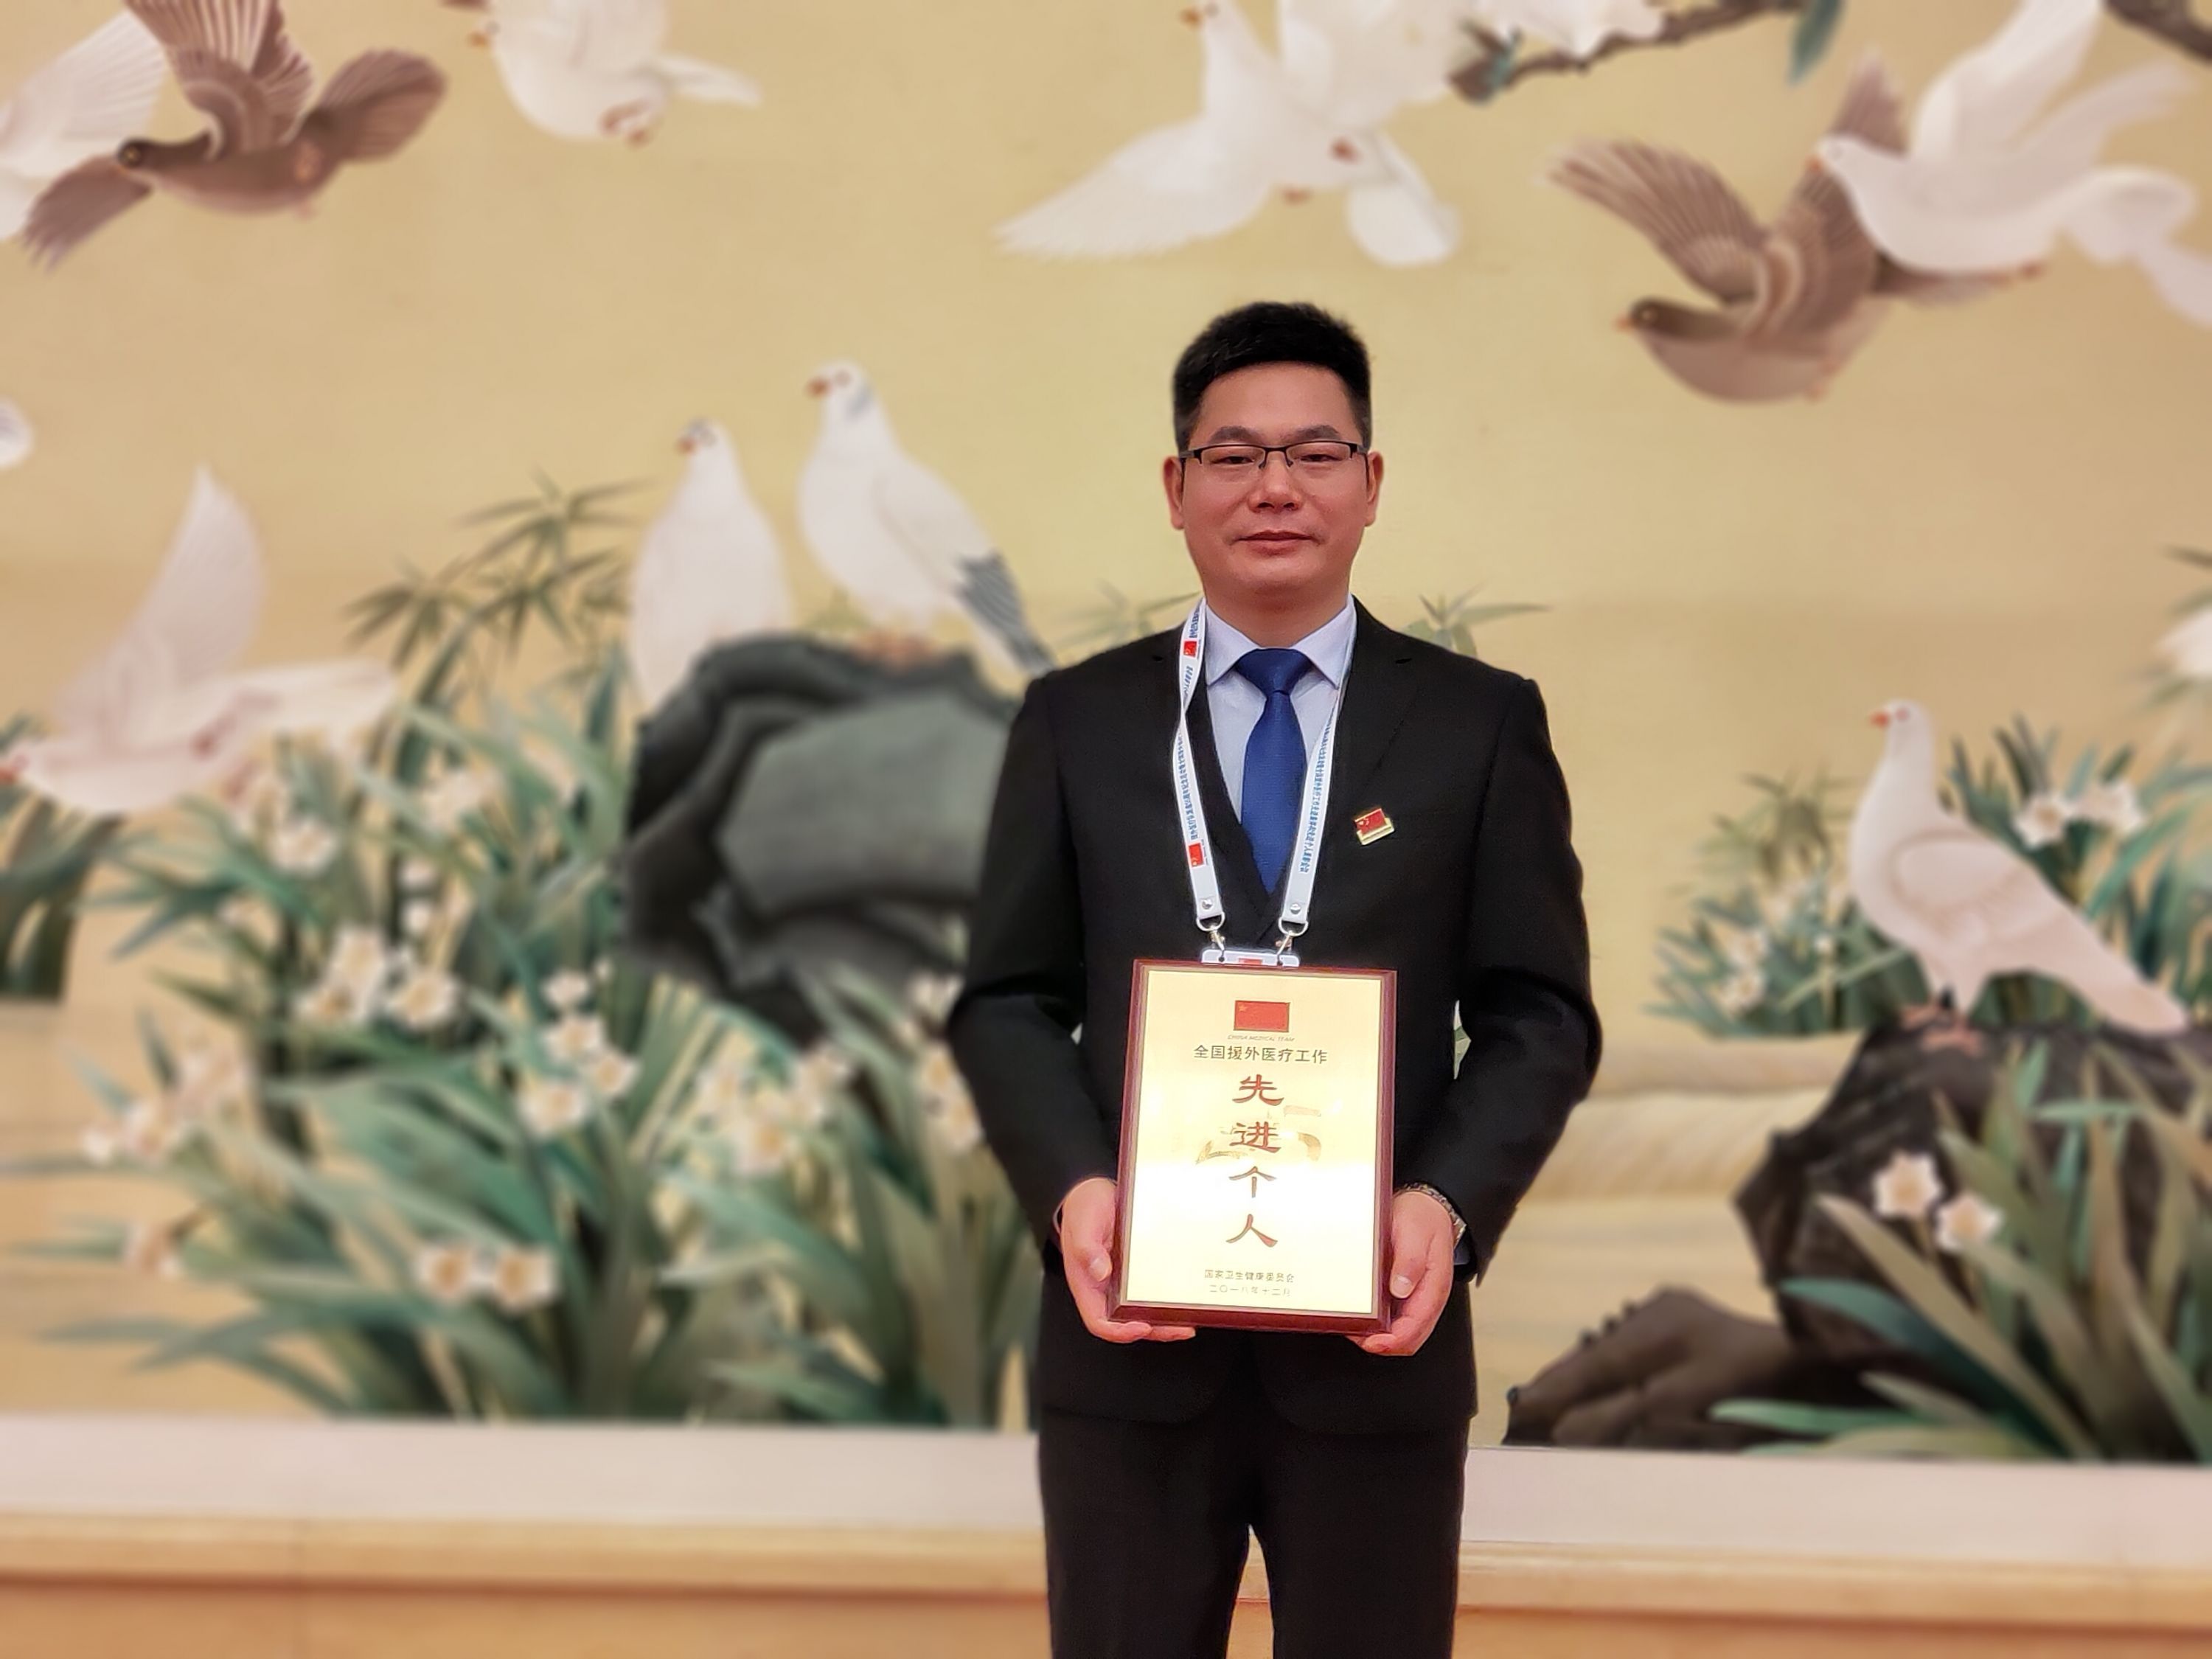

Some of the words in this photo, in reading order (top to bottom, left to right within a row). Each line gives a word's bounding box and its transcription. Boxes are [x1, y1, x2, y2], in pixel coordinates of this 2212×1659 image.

[1194, 1045, 1328, 1064] 全国援外医疗工作
